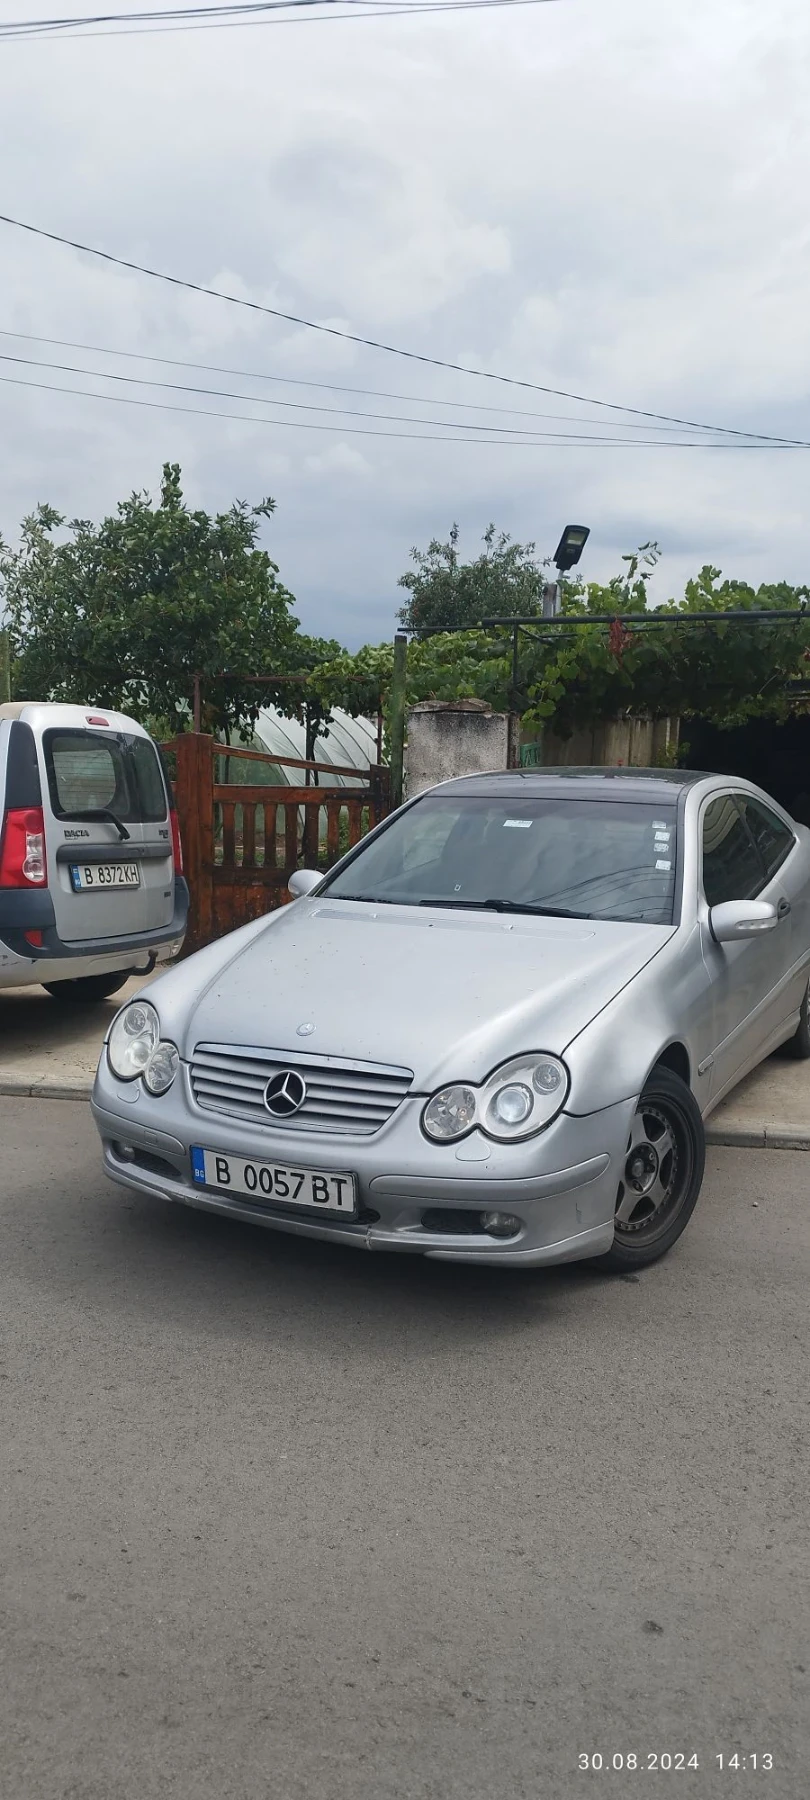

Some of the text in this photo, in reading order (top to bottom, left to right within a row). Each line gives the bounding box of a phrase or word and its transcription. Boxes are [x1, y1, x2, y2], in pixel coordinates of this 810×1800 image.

[64, 829, 90, 837] DACIA
[84, 867, 94, 885] B
[194, 1168, 205, 1178] BG
[215, 1157, 347, 1206] B 0057 BT
